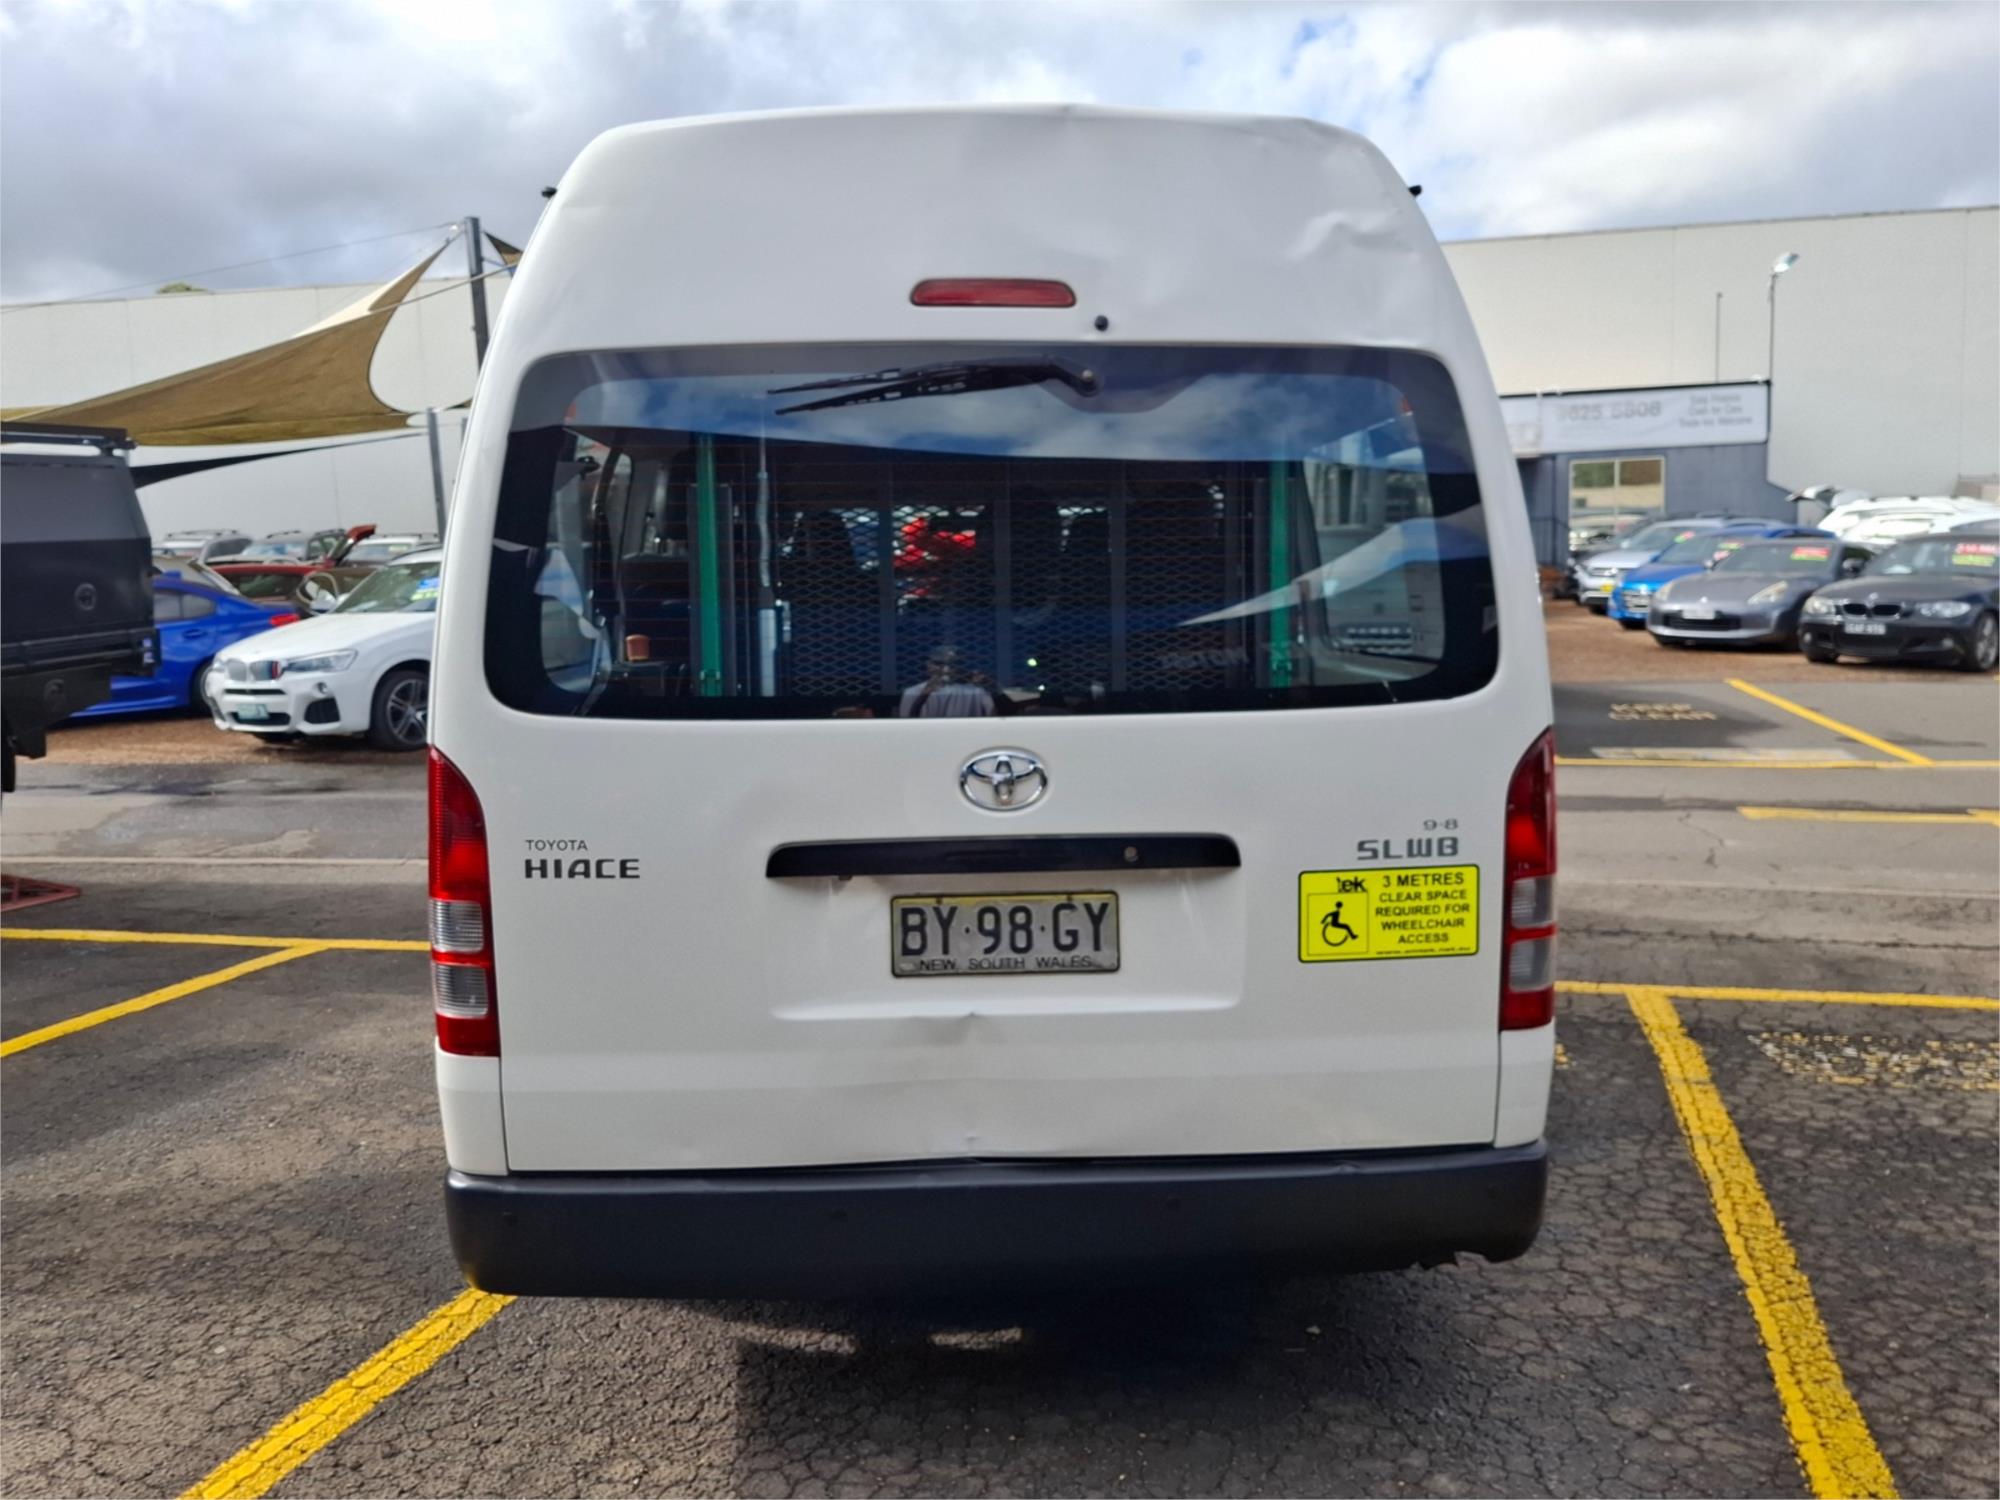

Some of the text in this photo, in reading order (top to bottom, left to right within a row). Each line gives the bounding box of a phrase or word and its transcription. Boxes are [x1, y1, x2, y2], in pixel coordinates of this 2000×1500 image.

[525, 839, 588, 851] TOYOTA
[1356, 836, 1459, 861] SLWB
[524, 858, 641, 879] HIACE
[1382, 872, 1465, 888] 3 METRES
[1378, 889, 1467, 903] CLEAR SPACE
[1375, 903, 1470, 917] REQUIRED FOR
[1381, 917, 1465, 931] WHEELCHAIR
[1398, 932, 1449, 944] ACCESS
[919, 954, 1093, 971] NEW SOUTH WALES
